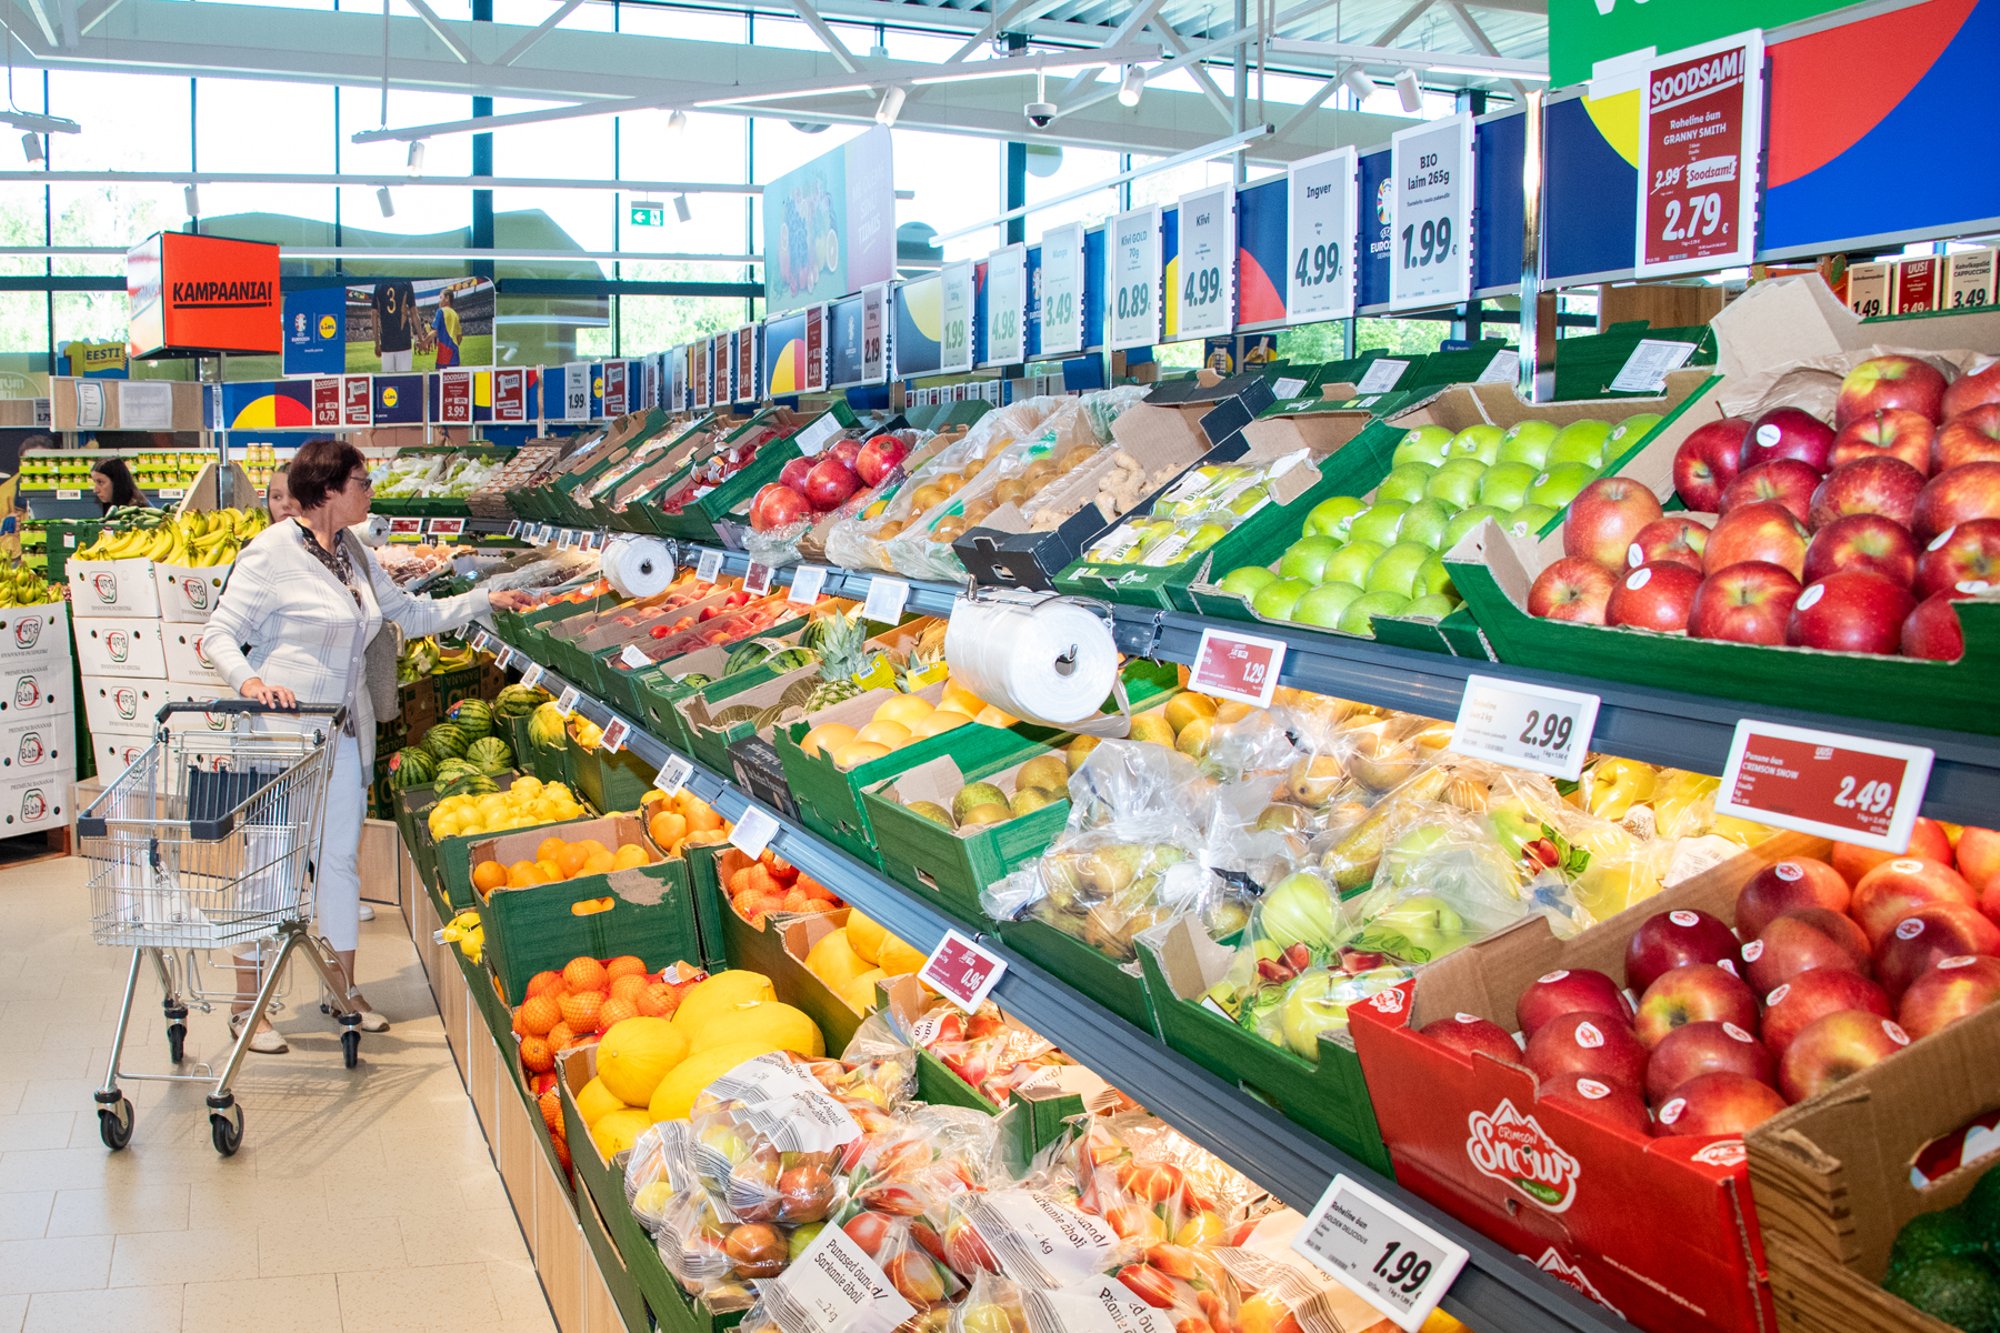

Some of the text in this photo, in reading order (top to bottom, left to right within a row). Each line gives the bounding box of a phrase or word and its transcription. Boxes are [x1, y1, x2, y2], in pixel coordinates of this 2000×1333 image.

[1651, 48, 1746, 105] SOODSAM!
[1670, 111, 1721, 130] Roheline õun
[1663, 123, 1727, 145] GRANNY SMITH
[1420, 153, 1438, 169] BIO
[1407, 170, 1450, 191] laim 265g
[1655, 163, 1733, 189] 2.99 Soodsam!
[1306, 183, 1332, 199] Ingver
[1196, 213, 1210, 227] Kiivi
[1662, 192, 1721, 241] 2.79
[1121, 231, 1147, 246] Kiivi GOLD
[1402, 216, 1451, 269] 1.99
[1129, 247, 1139, 259] 70g
[1295, 242, 1339, 287] 4.99
[1908, 261, 1928, 274] UUS!
[173, 281, 272, 308] KAMPAANIA!
[1184, 267, 1220, 307] 4.99
[1953, 288, 1986, 309] 3.49
[387, 287, 395, 314] 3
[1045, 291, 1072, 328] 3.49
[1117, 282, 1148, 320] 0.89
[1853, 299, 1880, 317] 1.49
[944, 319, 964, 351] 1.99
[992, 310, 1014, 341] 4.98
[86, 348, 120, 361] EESTI
[865, 337, 880, 364] 2.19
[447, 406, 465, 417] 3.99
[569, 393, 584, 409] 1.99
[319, 411, 335, 421] 0.79
[1243, 661, 1265, 684] 1.29
[1519, 710, 1573, 750] 2.99
[1742, 762, 1799, 780] CRIMSON SNOW
[1833, 775, 1893, 814] 2.49
[961, 968, 984, 991] 0.96
[1498, 1126, 1537, 1144] CRIMSON
[1474, 1120, 1573, 1184] Snow
[1330, 1201, 1368, 1229] Roheline õun
[1324, 1213, 1369, 1245] GOLDEN DELICIOUS
[826, 1239, 860, 1274] Punased
[1040, 1237, 1054, 1255] kg
[814, 1252, 865, 1305] Sarkanie āboli
[1372, 1241, 1432, 1293] 1.99
